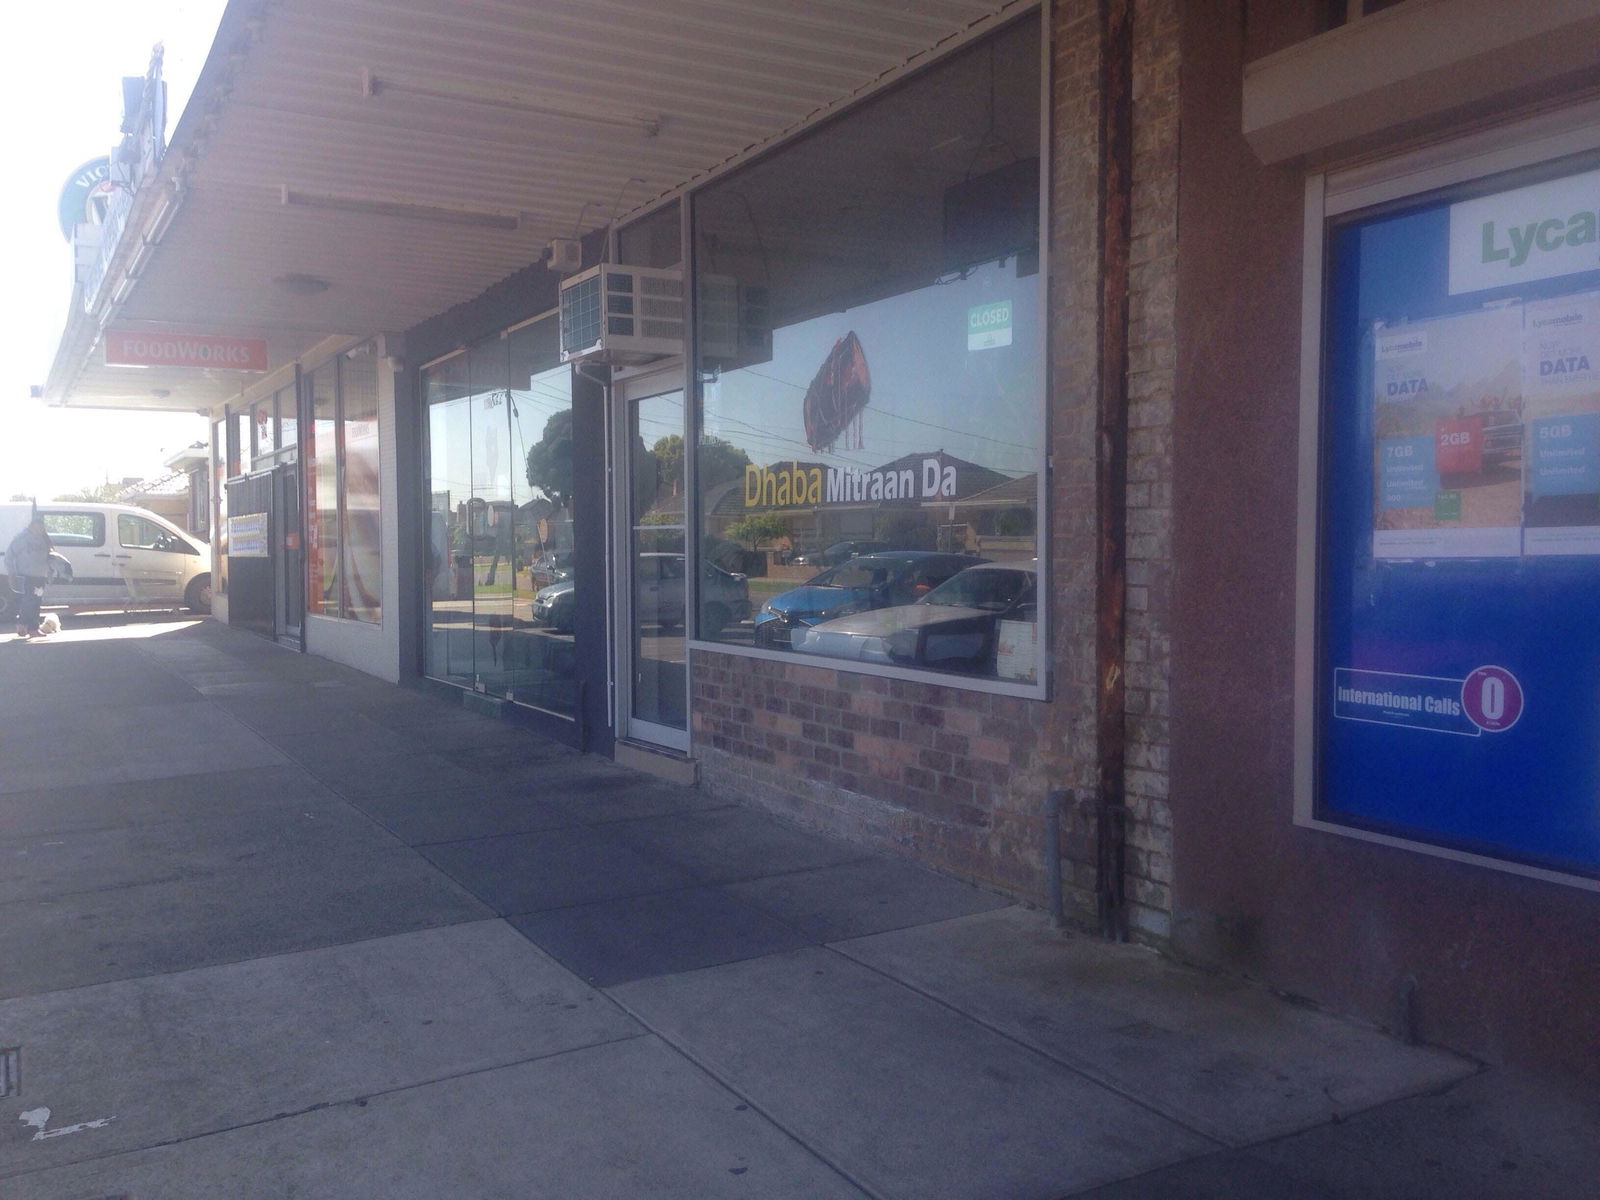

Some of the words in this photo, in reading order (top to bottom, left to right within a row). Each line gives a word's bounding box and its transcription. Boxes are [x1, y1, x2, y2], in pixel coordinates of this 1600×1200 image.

[1482, 211, 1600, 267] Lyca
[970, 307, 1009, 328] CLOSED
[122, 339, 250, 363] FOODWORKS
[1540, 355, 1590, 376] DATA
[1387, 378, 1429, 397] DATA
[1441, 431, 1470, 446] 2GB
[1386, 445, 1414, 458] 7GB
[745, 460, 822, 507] Dhaba
[826, 467, 915, 503] Mitraan
[922, 458, 958, 497] Da
[1338, 686, 1422, 711] International
[1425, 695, 1461, 717] Calls
[1481, 676, 1505, 720] 0
